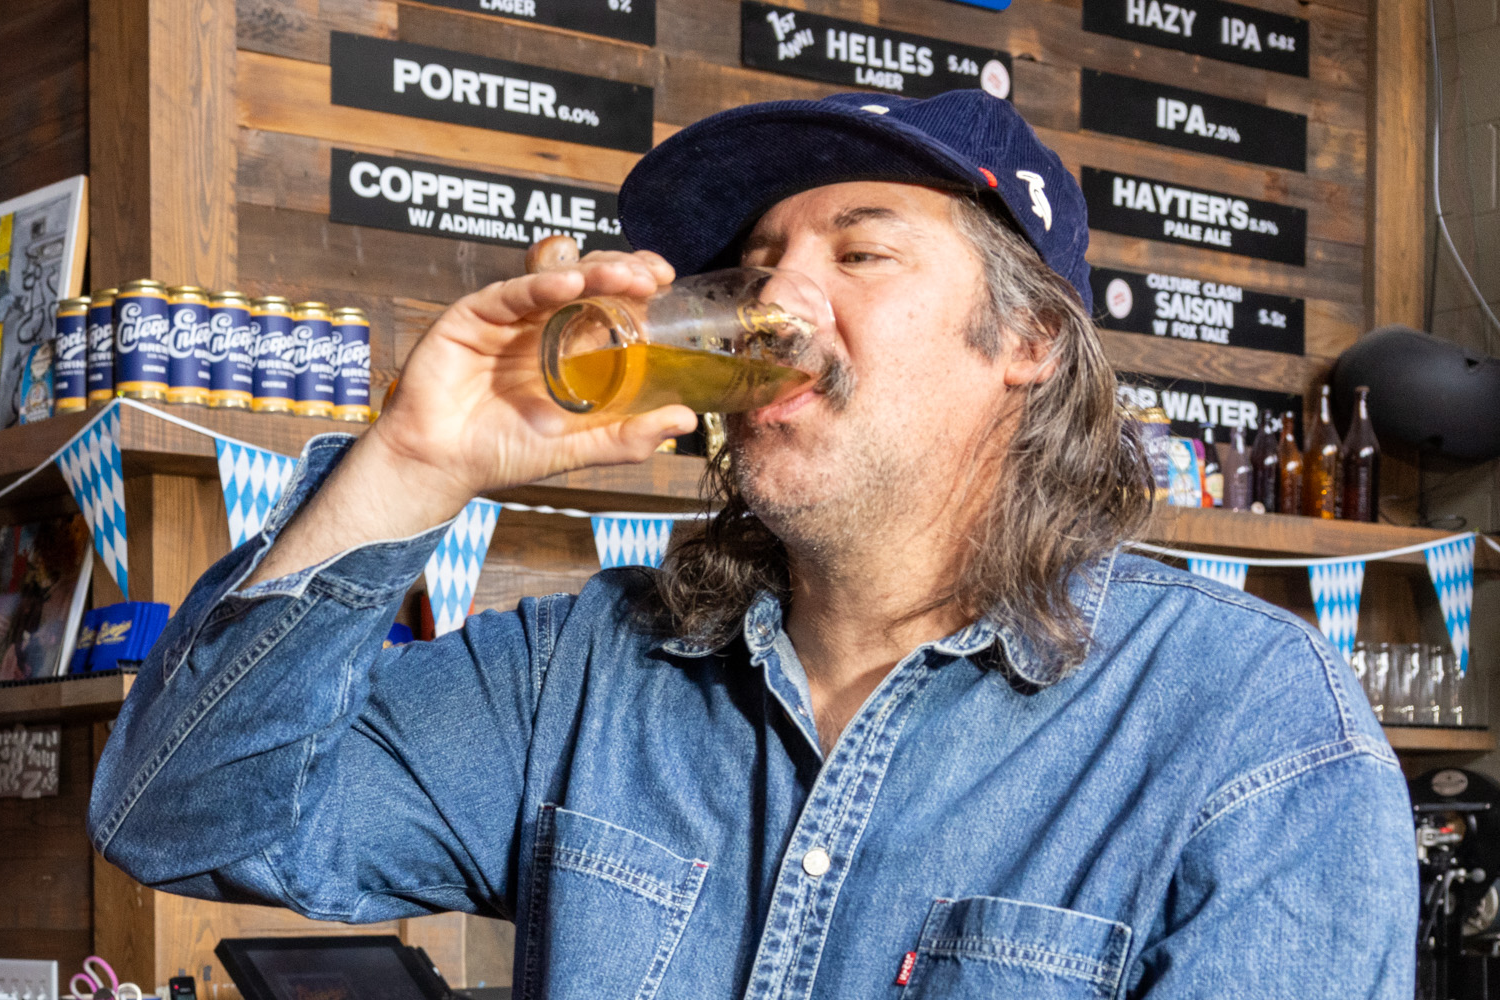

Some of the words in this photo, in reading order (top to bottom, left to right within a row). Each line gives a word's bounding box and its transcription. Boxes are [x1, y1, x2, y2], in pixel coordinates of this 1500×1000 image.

[1126, 0, 1197, 37] HAZY
[1221, 16, 1262, 52] IPA
[826, 28, 935, 77] HELLES
[393, 57, 556, 118] PORTER
[558, 105, 600, 127] 6.0%
[855, 67, 904, 91] LAGER
[1156, 97, 1208, 137] IPA
[349, 161, 515, 219] COPPER
[524, 190, 596, 232] ALE
[596, 217, 622, 236] 4.7
[1113, 176, 1249, 230] HAYTER'S
[408, 207, 434, 229] W/
[439, 214, 530, 243] ADMIRAL
[533, 226, 587, 250] MT
[1164, 219, 1202, 242] PALE
[1203, 227, 1232, 247] ALE
[1146, 273, 1200, 296] CULTURE
[1202, 282, 1243, 303] CLASH
[1155, 291, 1234, 329] SAISON
[117, 302, 169, 354] Enterp
[1171, 324, 1198, 340] FOX
[1200, 325, 1230, 344] TALE
[1117, 385, 1157, 409] OP
[1161, 390, 1258, 430] WATER
